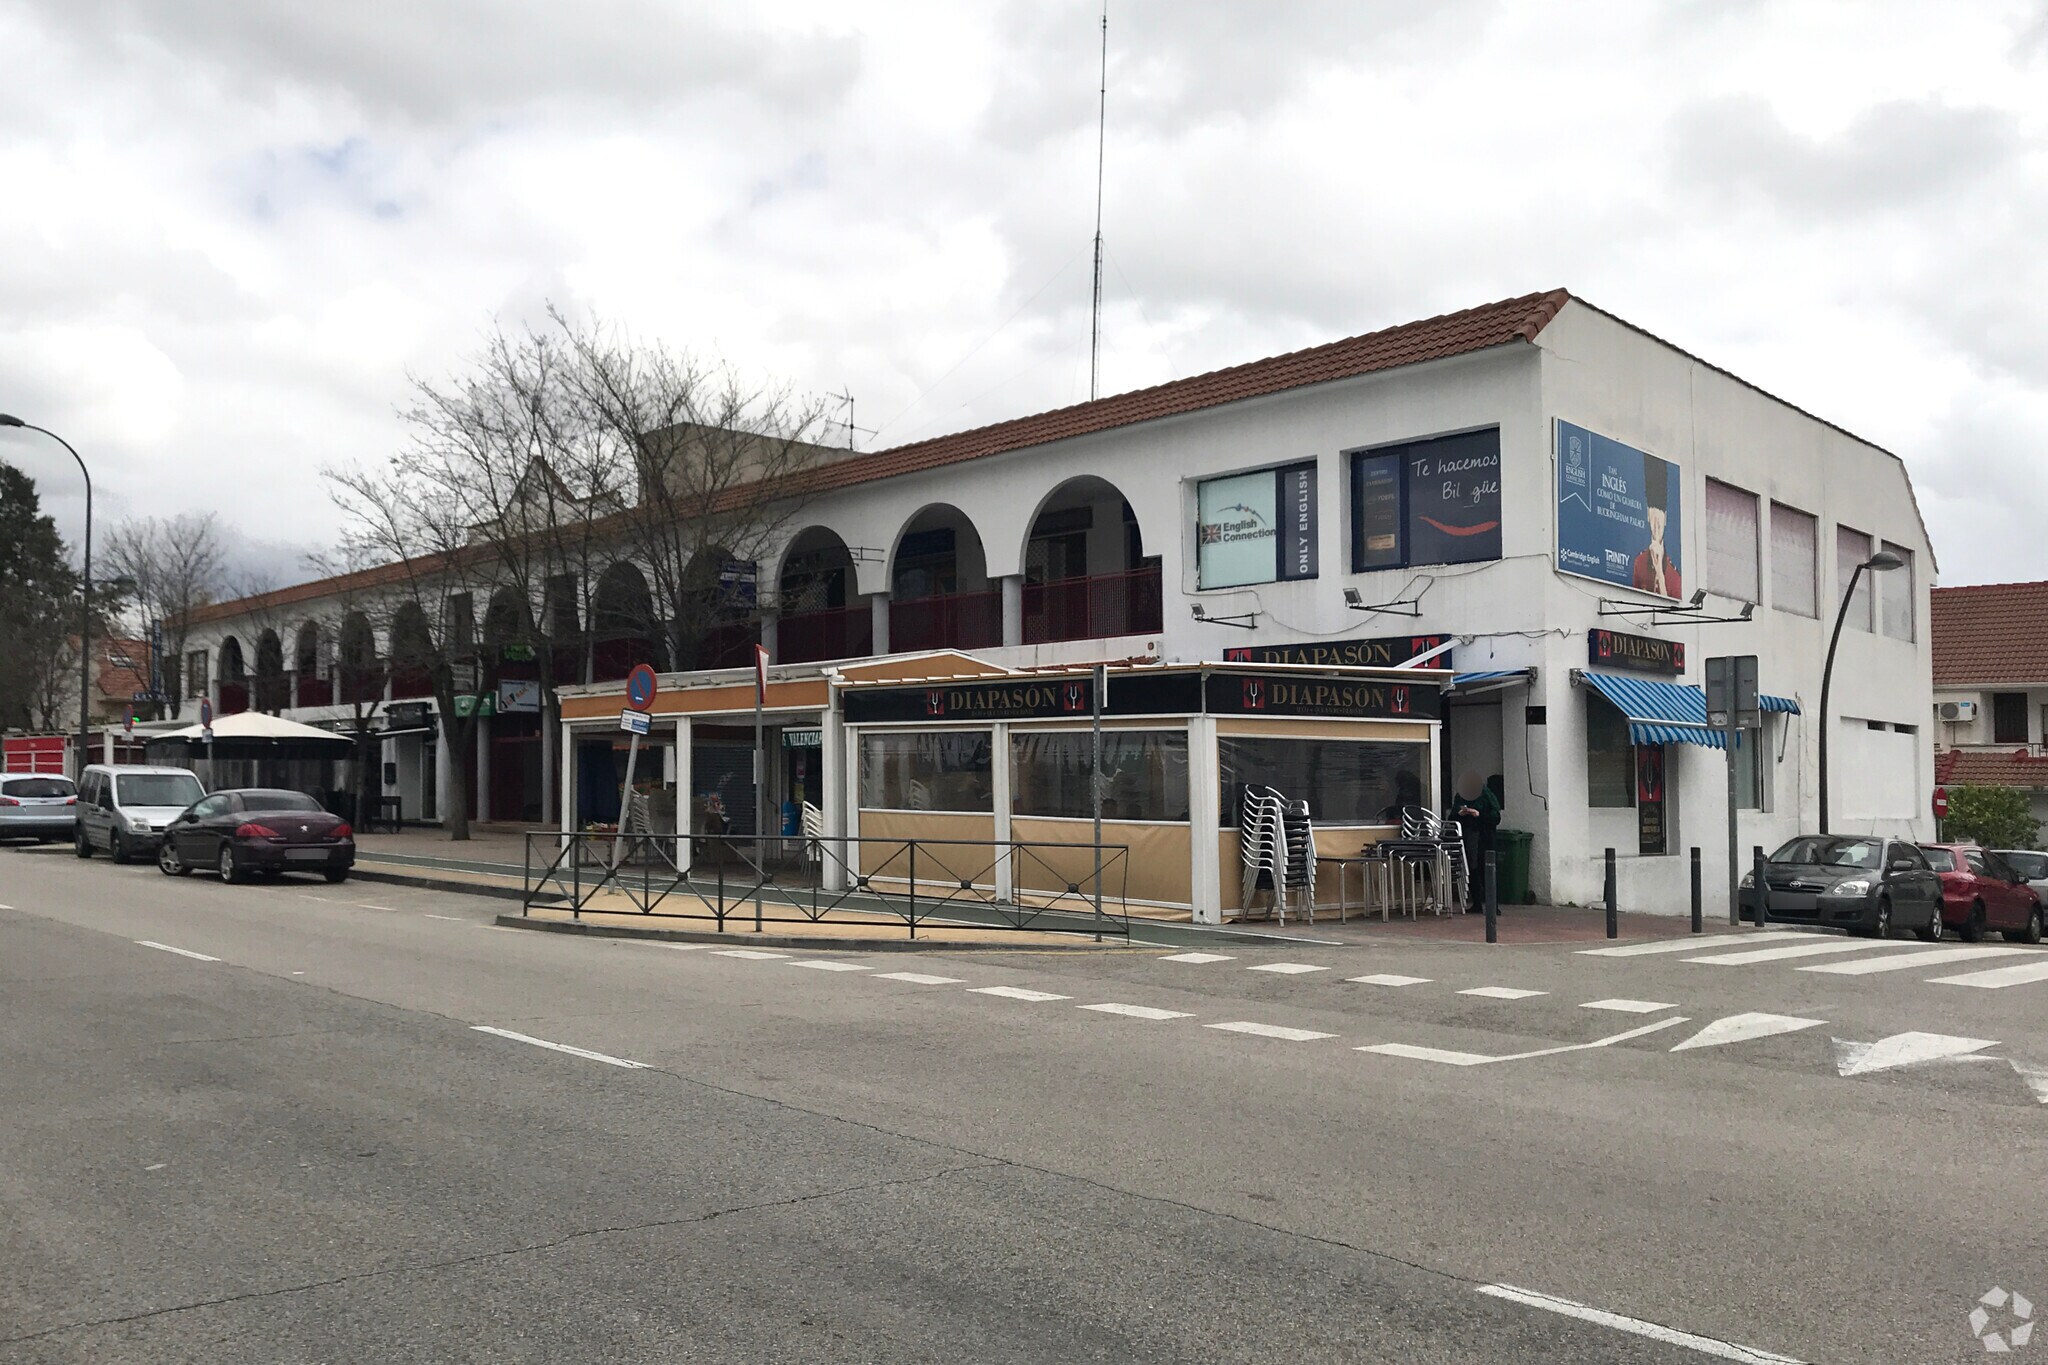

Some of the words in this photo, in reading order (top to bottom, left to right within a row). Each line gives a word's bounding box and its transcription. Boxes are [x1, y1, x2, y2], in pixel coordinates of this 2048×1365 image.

[1411, 458, 1430, 477] Te
[1438, 454, 1498, 474] hacemos
[1565, 465, 1586, 479] ENGLISH
[1442, 481, 1460, 499] Bil
[1471, 480, 1499, 503] güe
[1602, 473, 1627, 493] INGLÉS
[1299, 471, 1308, 531] ENGLISH
[1596, 488, 1614, 499] COMO
[1614, 494, 1621, 503] UN
[1223, 519, 1257, 532] English
[1597, 506, 1630, 523] BUCKINGHAM
[1630, 516, 1645, 528] PALACE
[1223, 529, 1276, 542] Connection
[1299, 537, 1308, 573] ONLY
[1566, 549, 1587, 562] Cambridge
[1587, 554, 1600, 565] English
[1605, 548, 1630, 566] TRINITY
[1262, 641, 1392, 665] DIAPASÓN
[950, 684, 1057, 710] DIAPASÓN
[1272, 684, 1385, 708] DIAPASÓN
